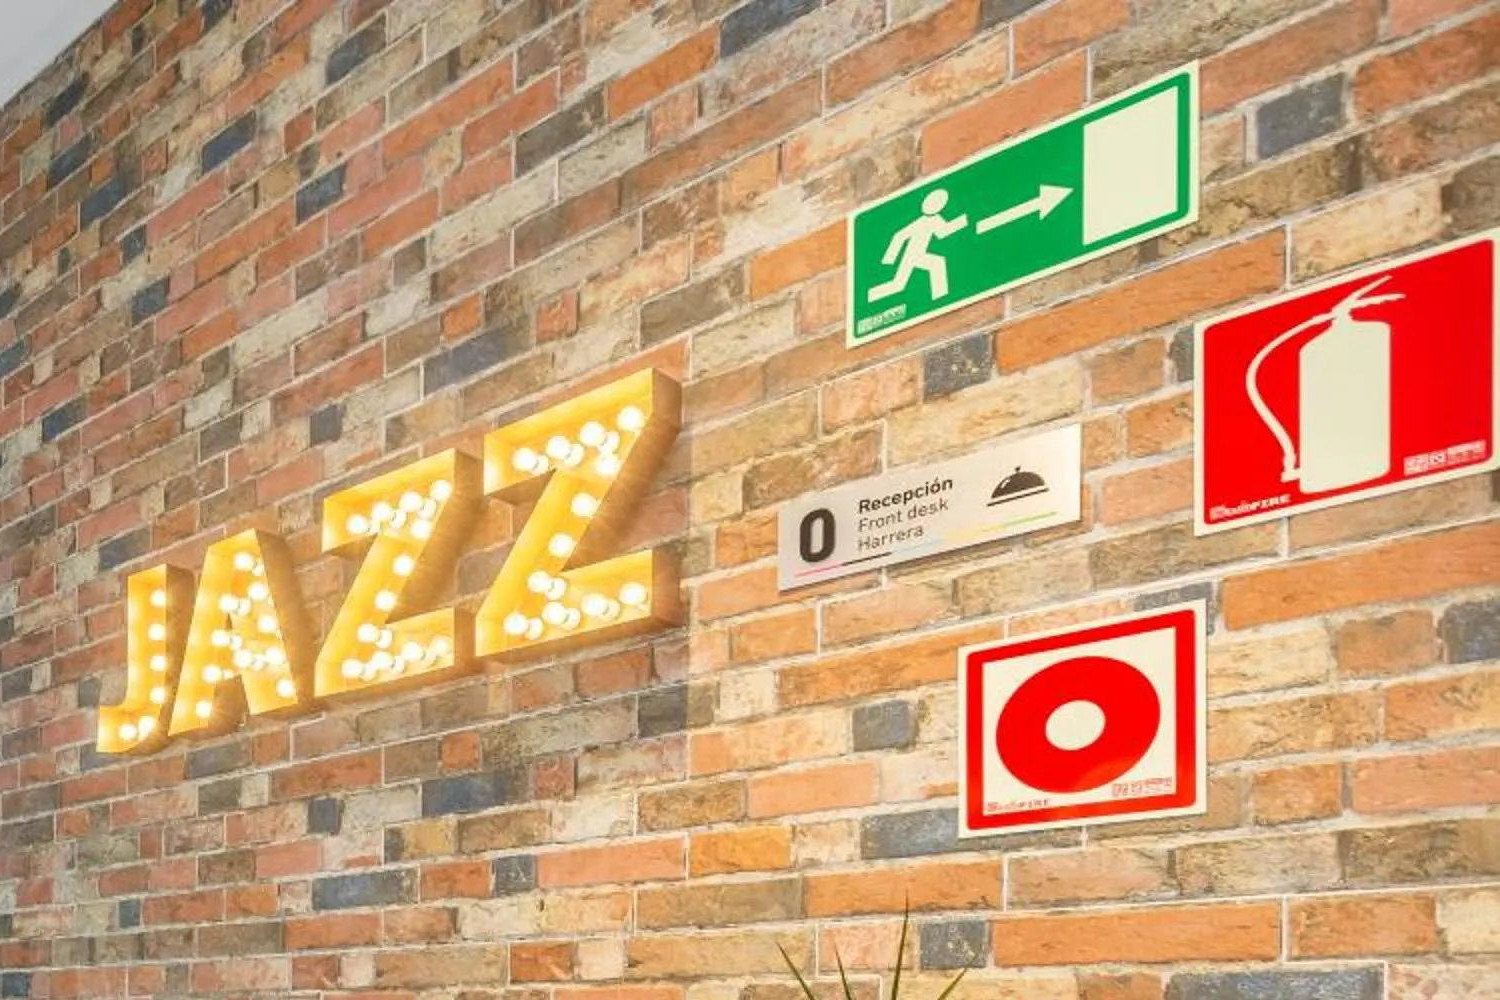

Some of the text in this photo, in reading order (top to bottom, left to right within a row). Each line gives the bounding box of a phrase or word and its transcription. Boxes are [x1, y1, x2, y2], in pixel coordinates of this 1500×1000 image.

[858, 477, 954, 514] Recepción
[859, 499, 949, 533] Front desk
[800, 508, 836, 562] 0
[858, 526, 924, 551] Harrera
[97, 368, 682, 752] JAZZ
